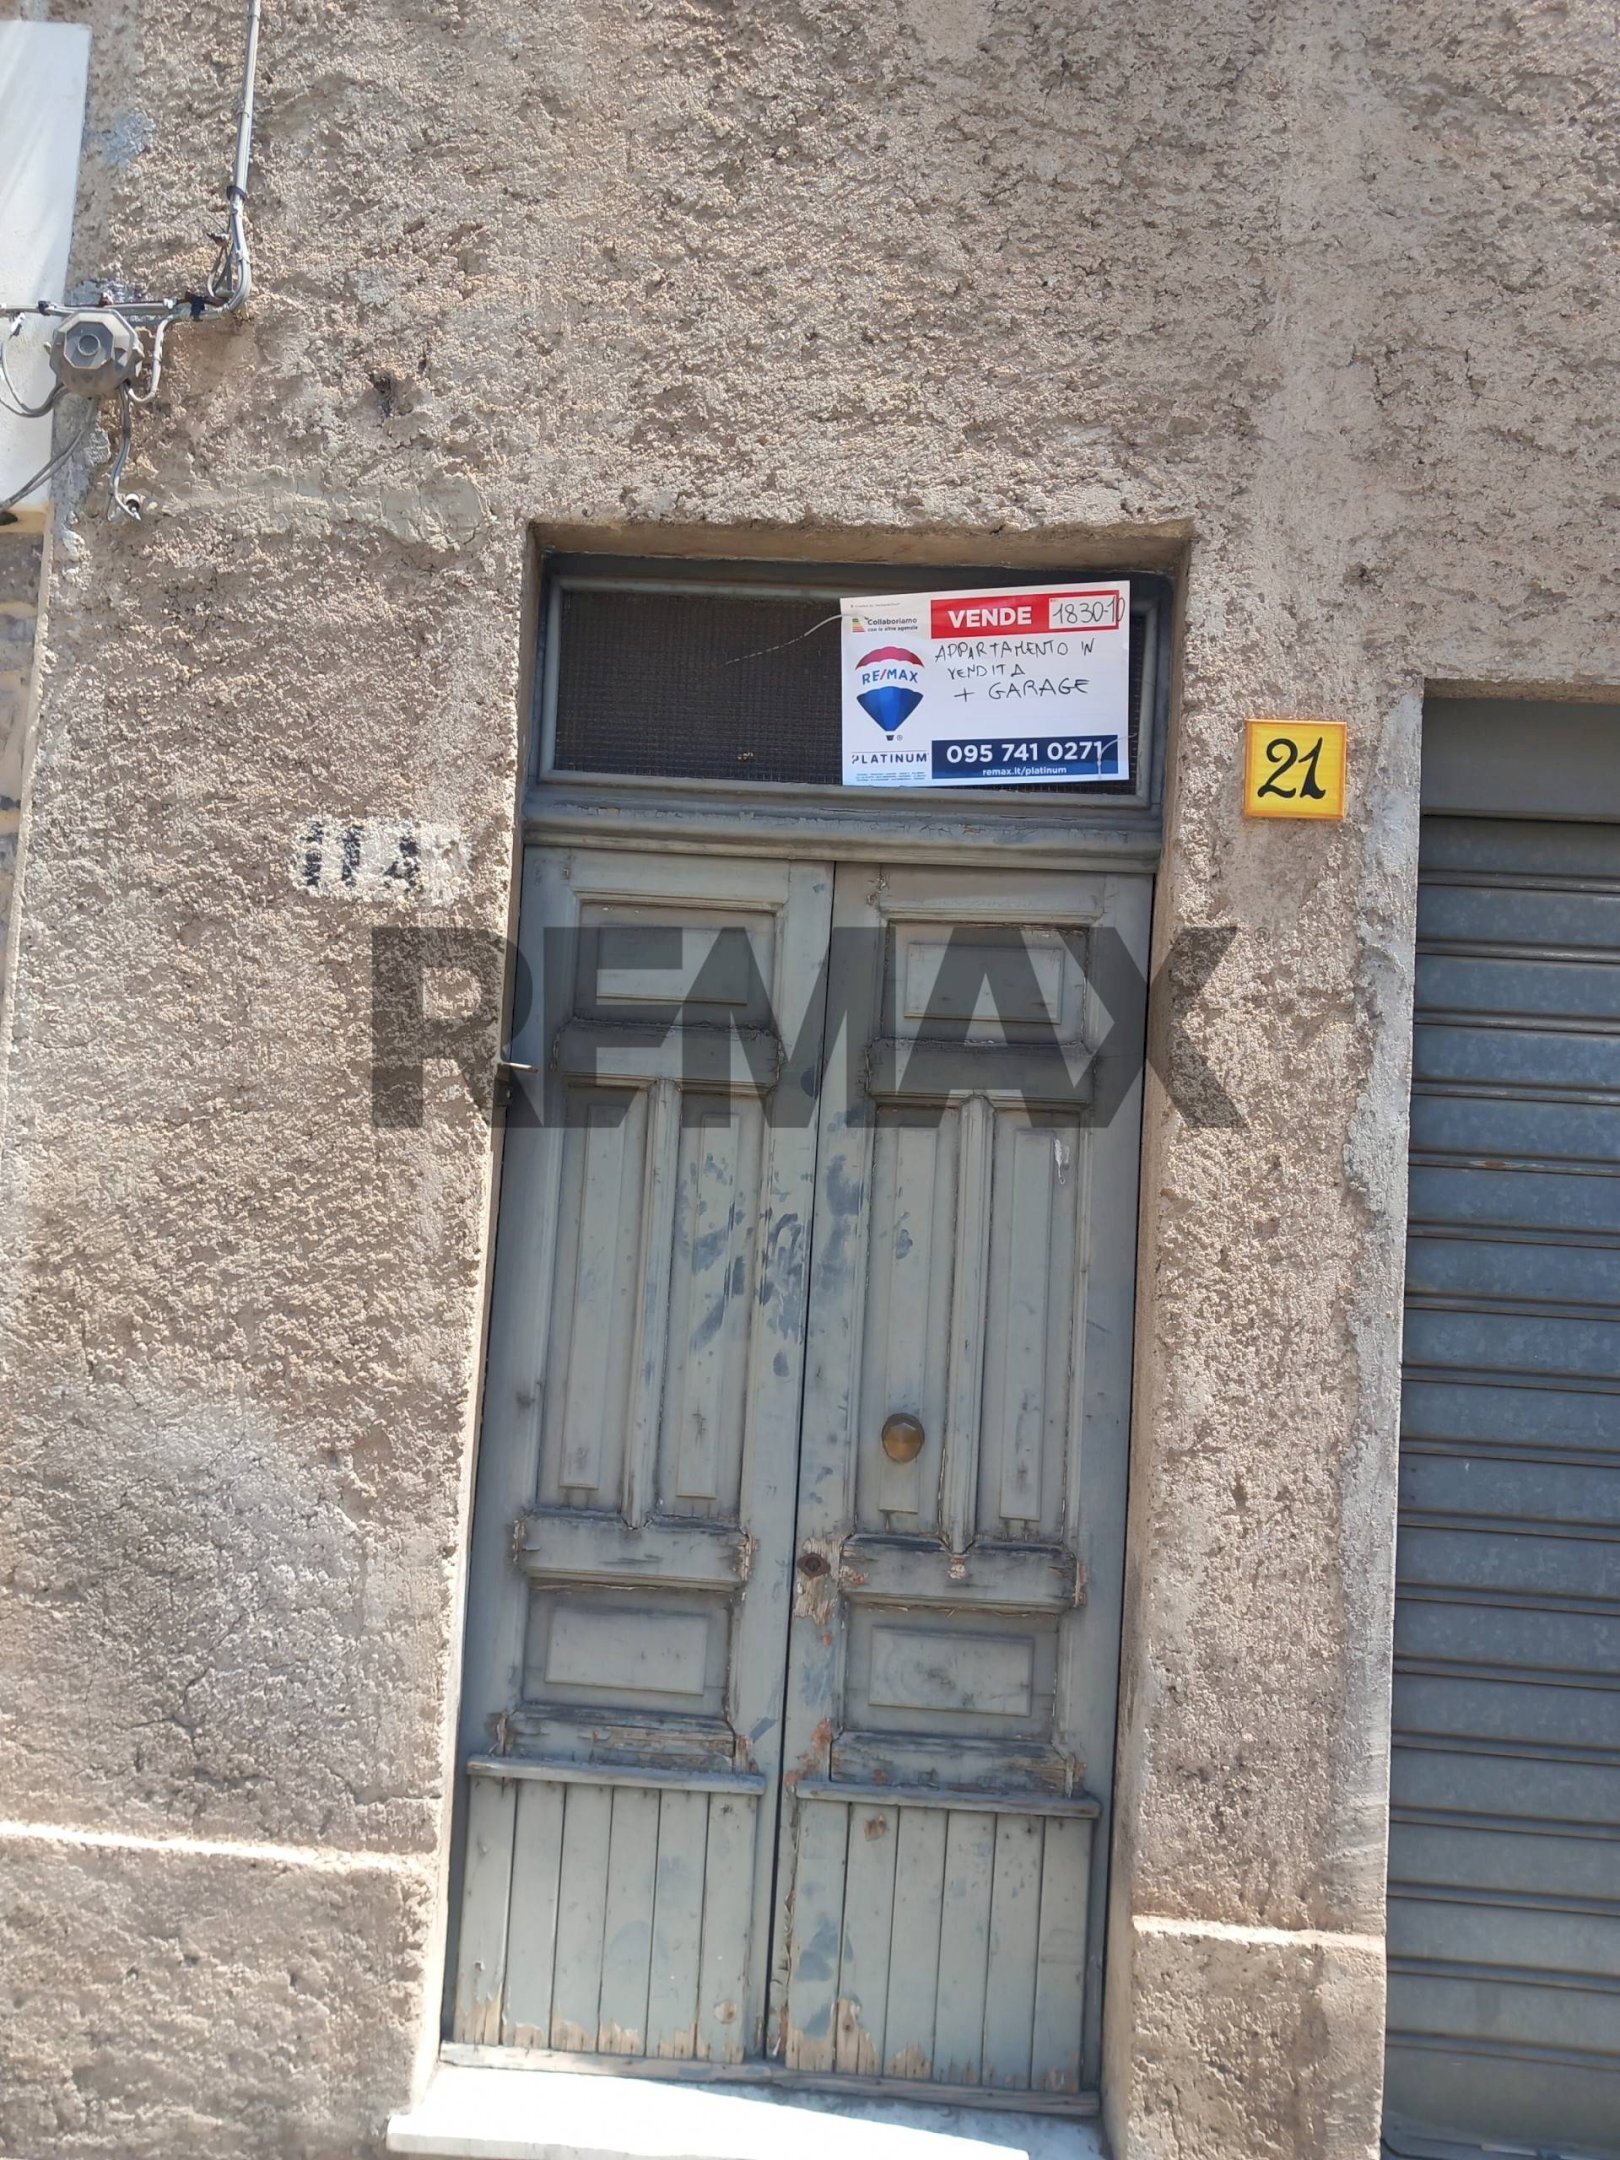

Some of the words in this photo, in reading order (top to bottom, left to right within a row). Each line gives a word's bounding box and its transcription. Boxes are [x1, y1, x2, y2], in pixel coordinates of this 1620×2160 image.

[867, 617, 918, 626] Collaboriamo
[948, 607, 1032, 629] VENDE
[862, 668, 918, 685] RE/MAX
[988, 677, 1090, 700] GARAGE
[851, 753, 927, 765] PLATINUM
[946, 745, 993, 763] 095
[1001, 743, 1038, 762] 741
[1047, 741, 1102, 761] 0271
[982, 766, 1067, 777] remax.it/platinum
[1257, 736, 1326, 799] 21
